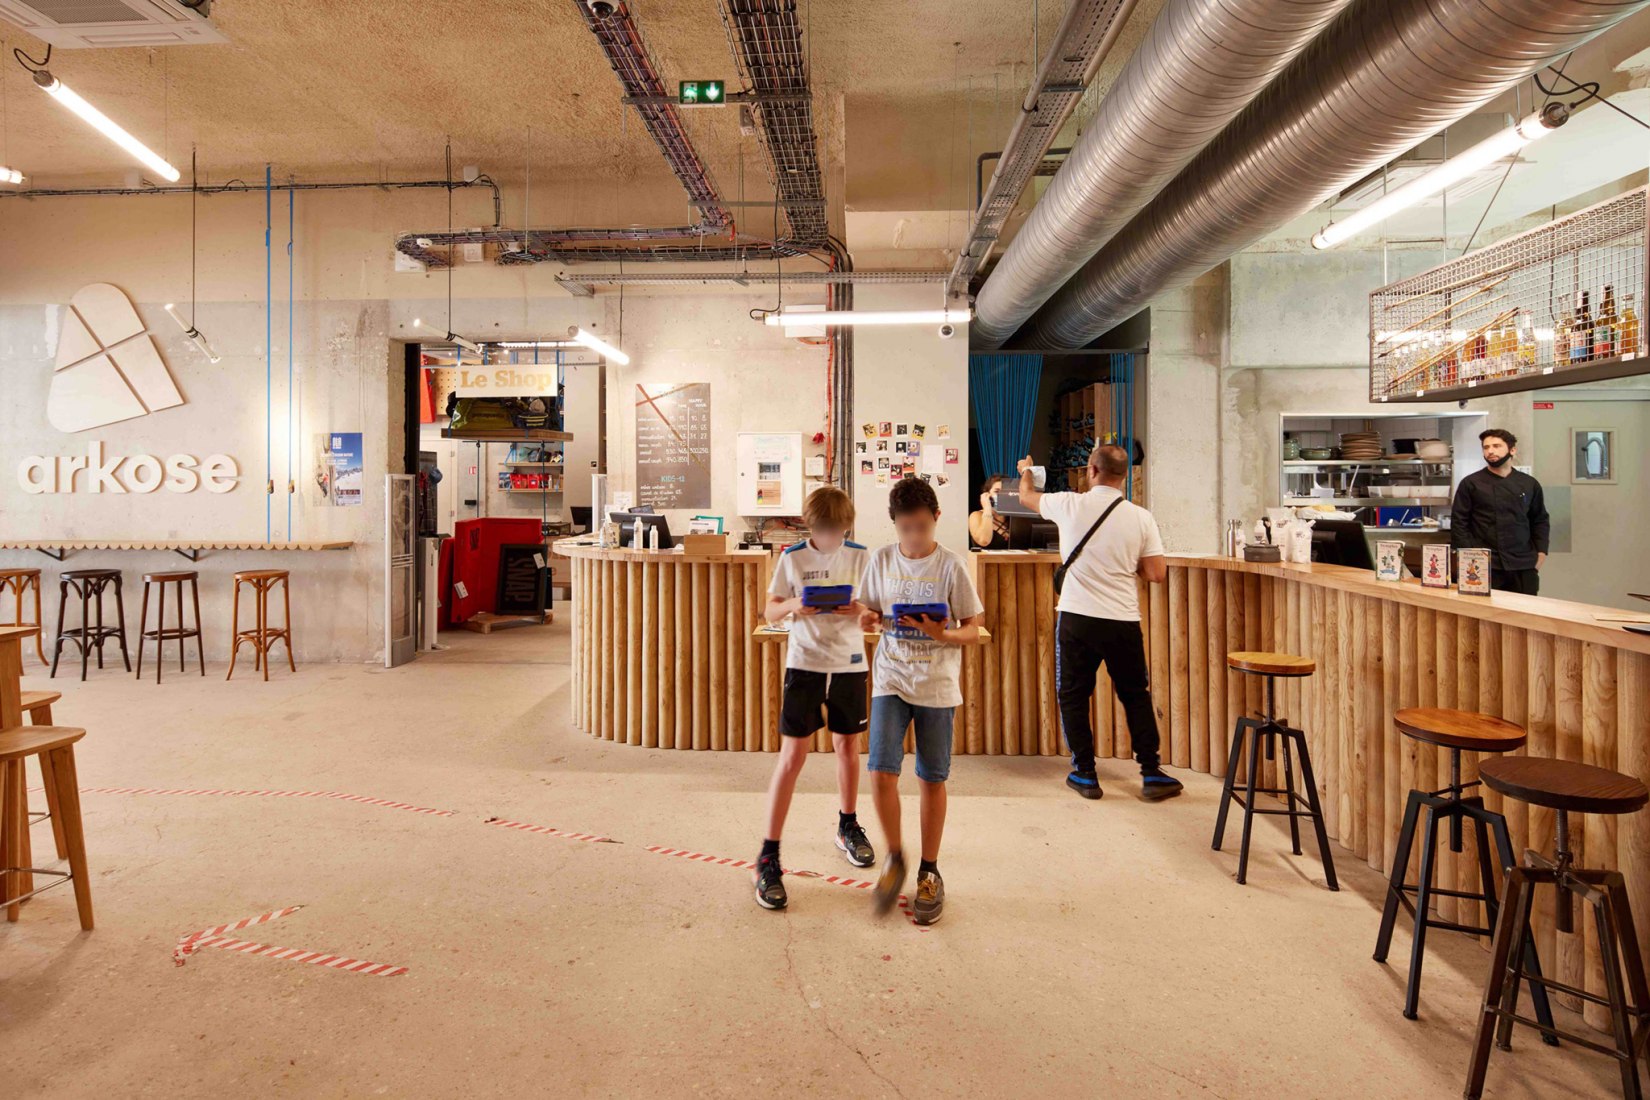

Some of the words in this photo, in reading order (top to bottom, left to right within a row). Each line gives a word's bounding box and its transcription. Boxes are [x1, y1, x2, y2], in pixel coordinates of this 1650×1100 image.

[460, 371, 487, 388] Le
[494, 370, 552, 391] Shop
[17, 441, 244, 494] arkose
[919, 581, 934, 597] IS
